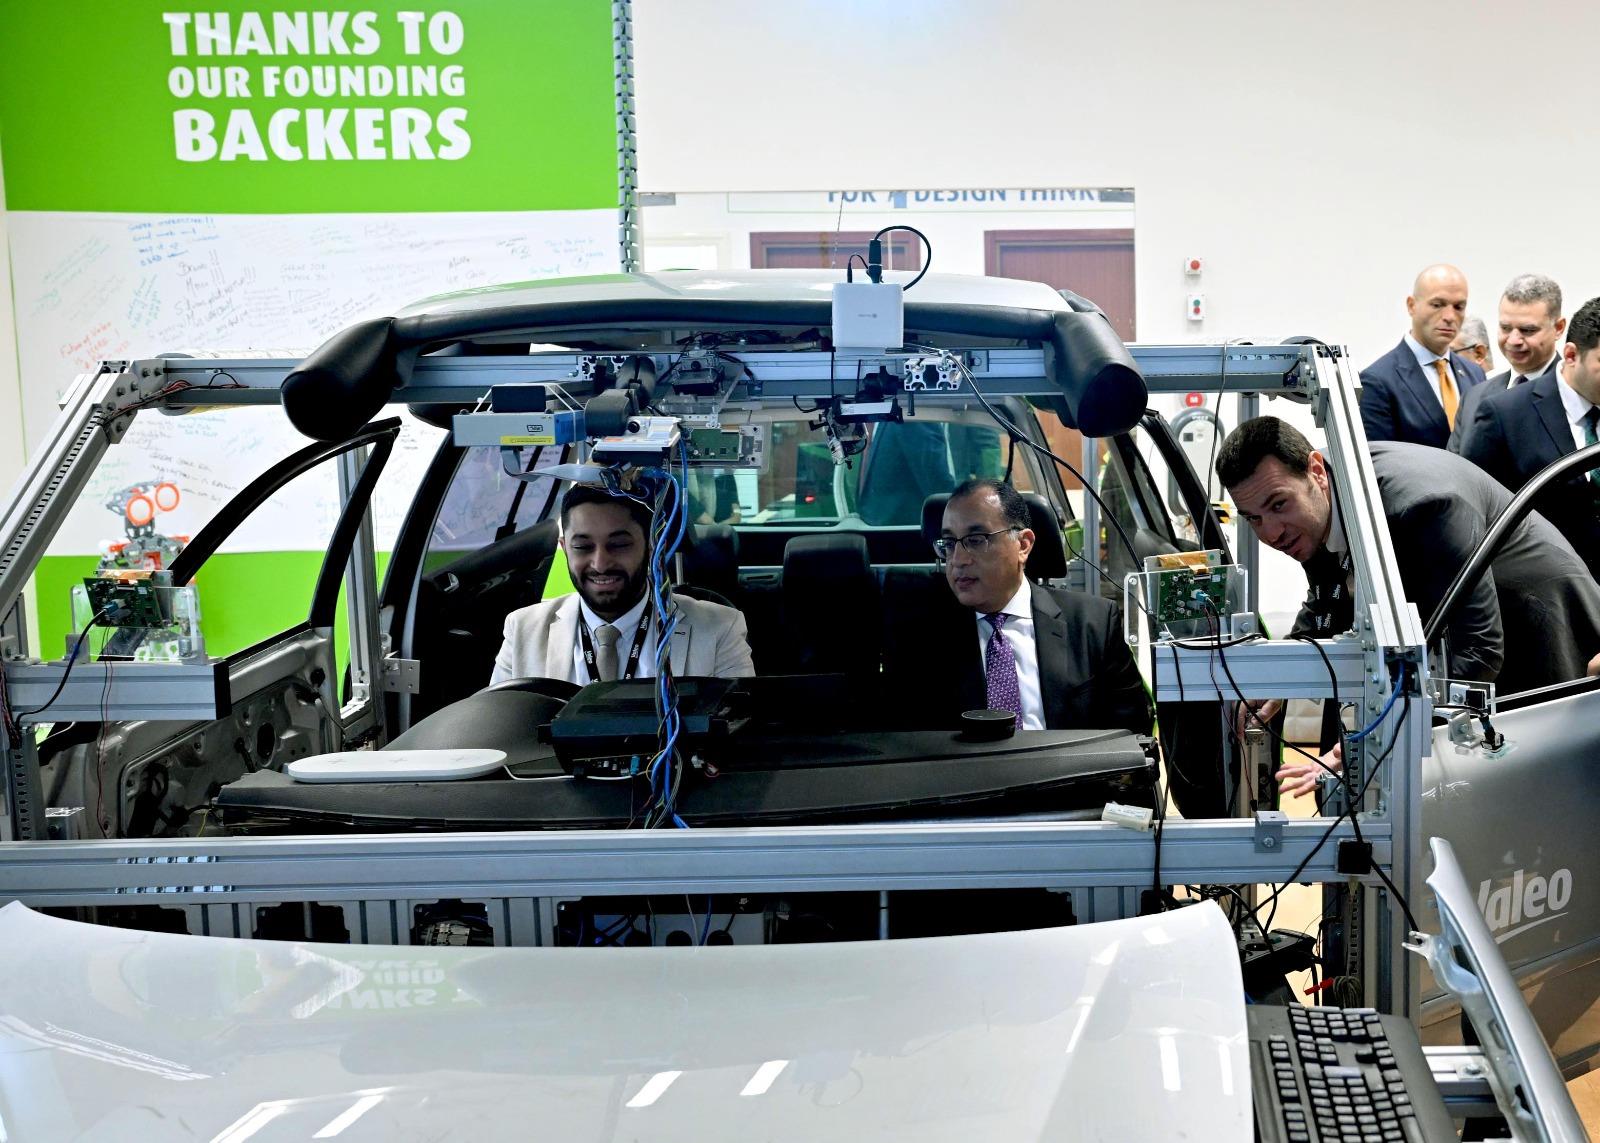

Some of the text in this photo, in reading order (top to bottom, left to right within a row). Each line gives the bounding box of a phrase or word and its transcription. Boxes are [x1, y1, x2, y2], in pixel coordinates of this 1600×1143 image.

[163, 11, 464, 55] THANKS TO
[169, 65, 465, 97] OUR FOUNDING
[174, 107, 471, 161] BACKERS
[914, 190, 1006, 202] DESIGN
[1019, 189, 1100, 201] THINK
